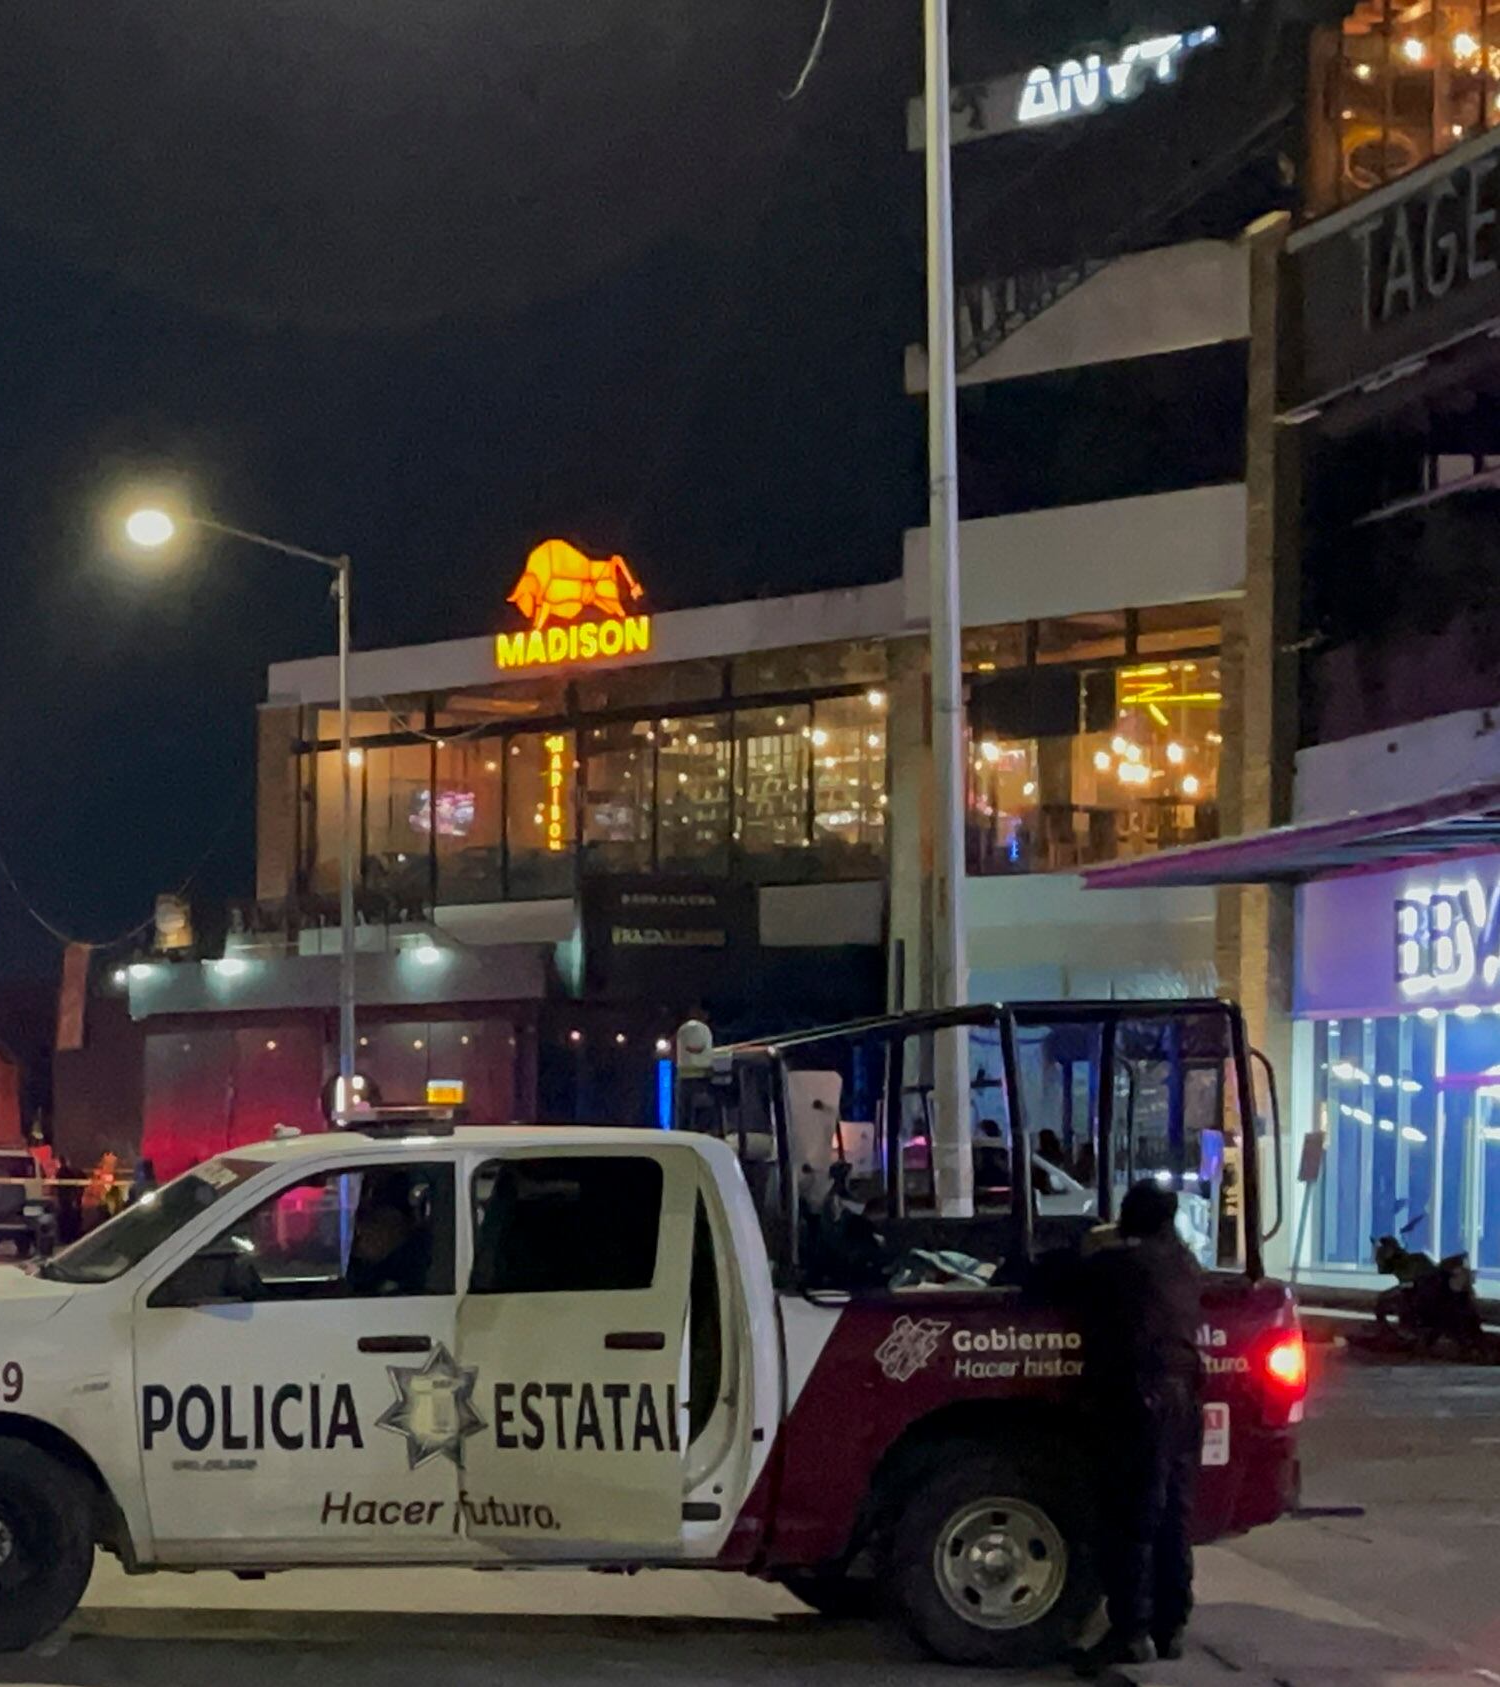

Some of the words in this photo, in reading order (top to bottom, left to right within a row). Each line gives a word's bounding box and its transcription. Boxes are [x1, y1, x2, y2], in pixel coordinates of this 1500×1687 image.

[496, 615, 649, 669] MADISON
[952, 1326, 1082, 1353] Gobierno
[954, 1357, 1018, 1379] Hacer
[1023, 1356, 1085, 1377] histor
[142, 1381, 365, 1452] POLICIA
[321, 1490, 445, 1526] Hacer
[453, 1489, 561, 1534] futuro.
